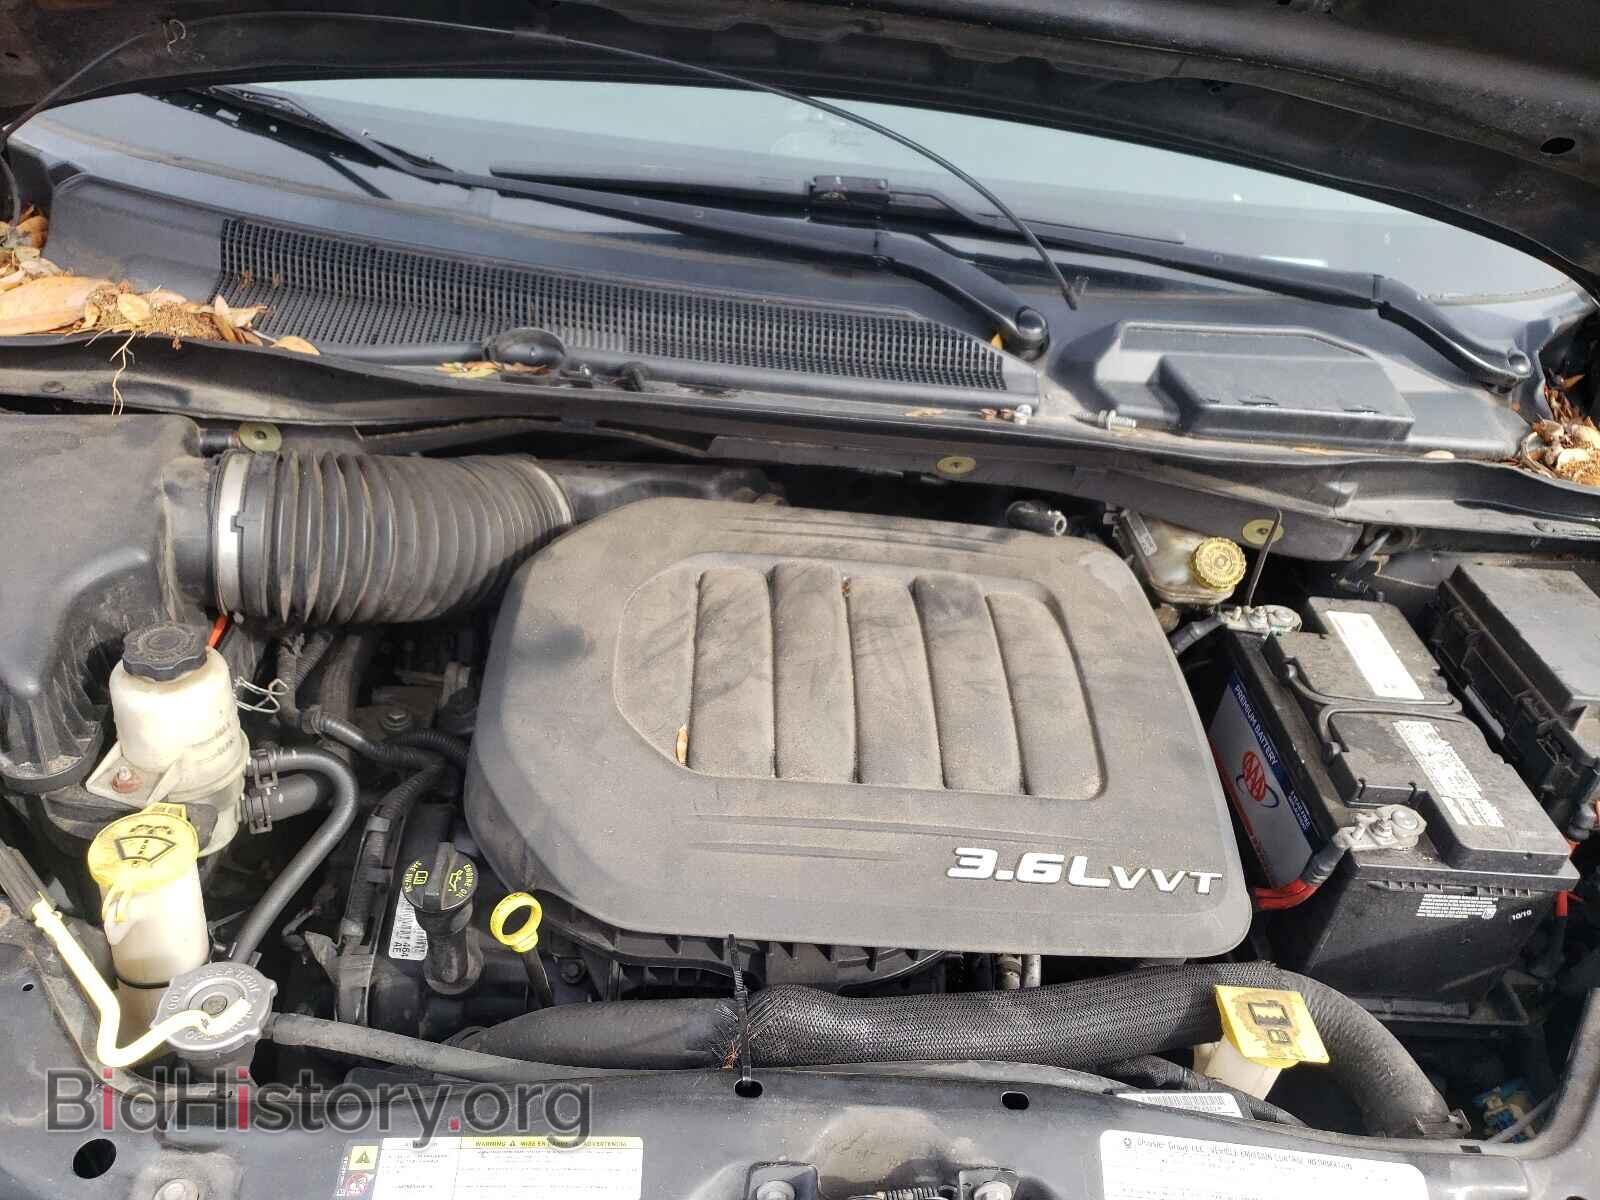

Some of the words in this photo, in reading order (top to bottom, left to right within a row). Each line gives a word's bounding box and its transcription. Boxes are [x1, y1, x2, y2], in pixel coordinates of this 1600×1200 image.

[1234, 684, 1257, 724] PREMIUM
[1255, 723, 1279, 766] BATTERY
[463, 863, 474, 887] ENGINE
[947, 847, 1111, 888] 3.6L
[1111, 865, 1223, 895] VVT
[455, 888, 468, 898] OIL
[475, 1140, 506, 1148] WARNING
